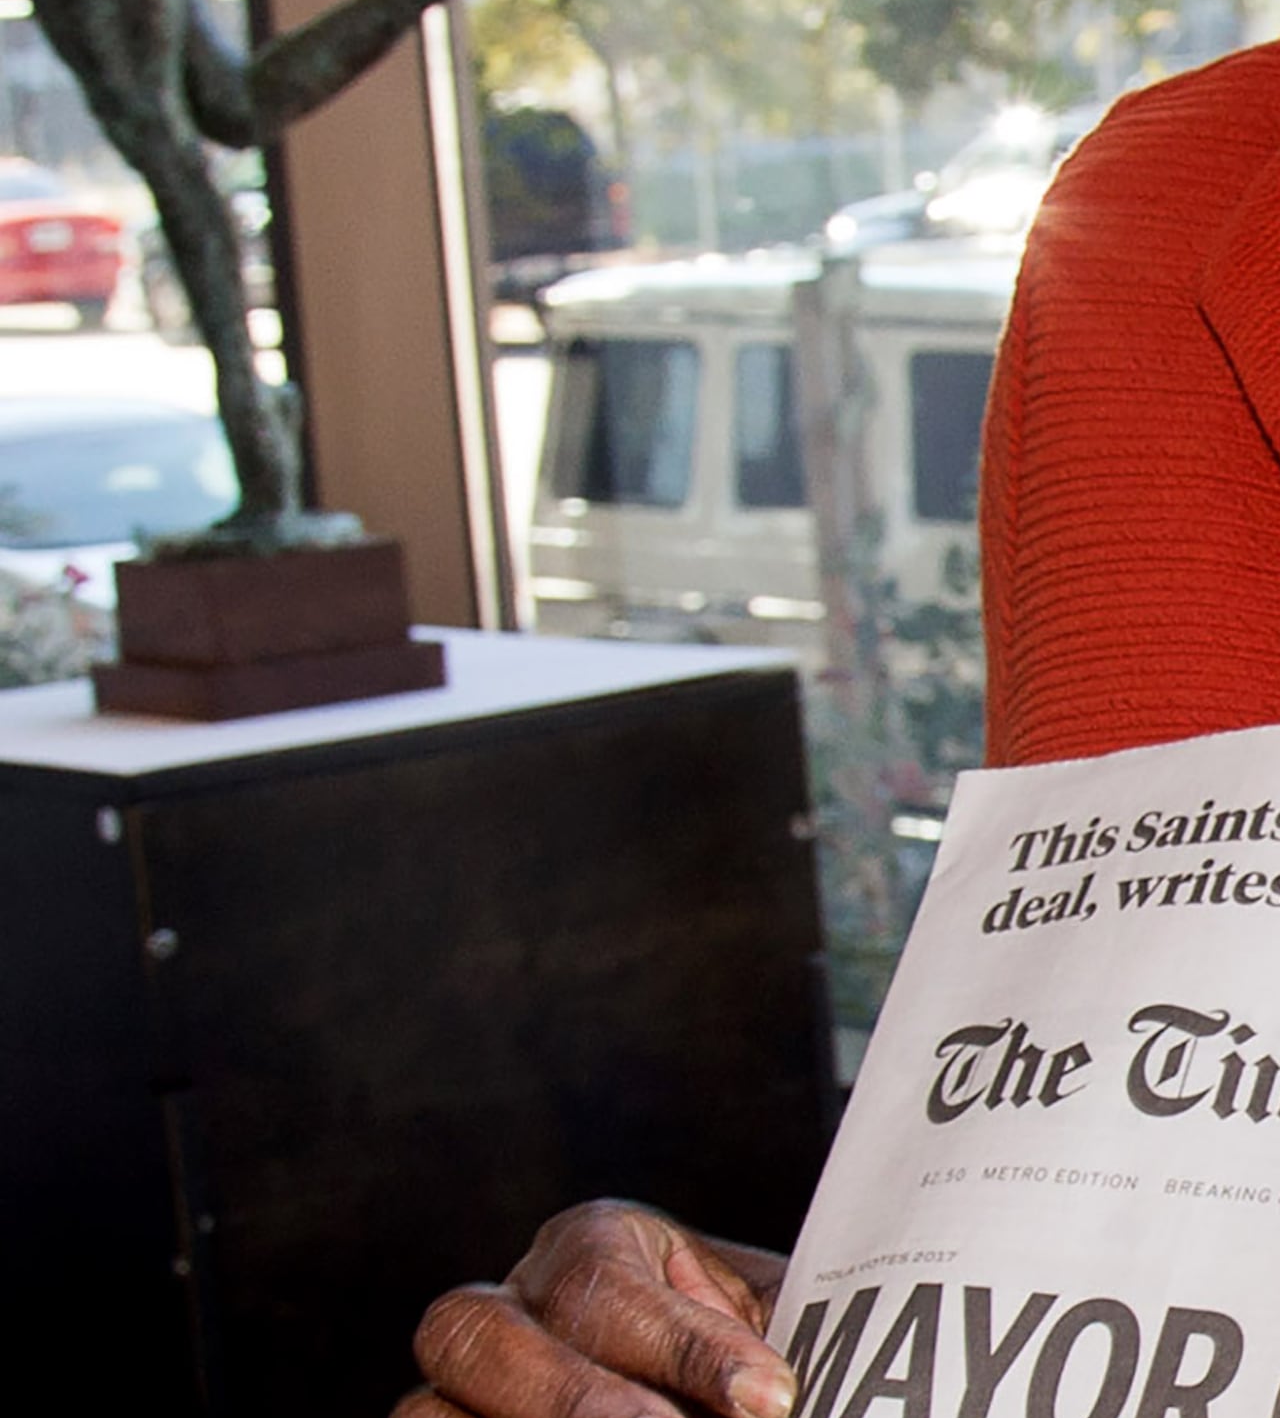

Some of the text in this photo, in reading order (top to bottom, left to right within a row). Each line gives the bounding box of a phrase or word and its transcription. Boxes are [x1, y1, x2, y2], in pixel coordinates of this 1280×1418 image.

[1008, 817, 1119, 873] This
[981, 873, 1098, 935] deal,
[927, 1016, 1094, 1126] The
[981, 1166, 1048, 1183] METRO
[1055, 1168, 1140, 1190] EDITION
[1164, 1177, 1272, 1204] BREAKING
[911, 1250, 958, 1264] 2017
